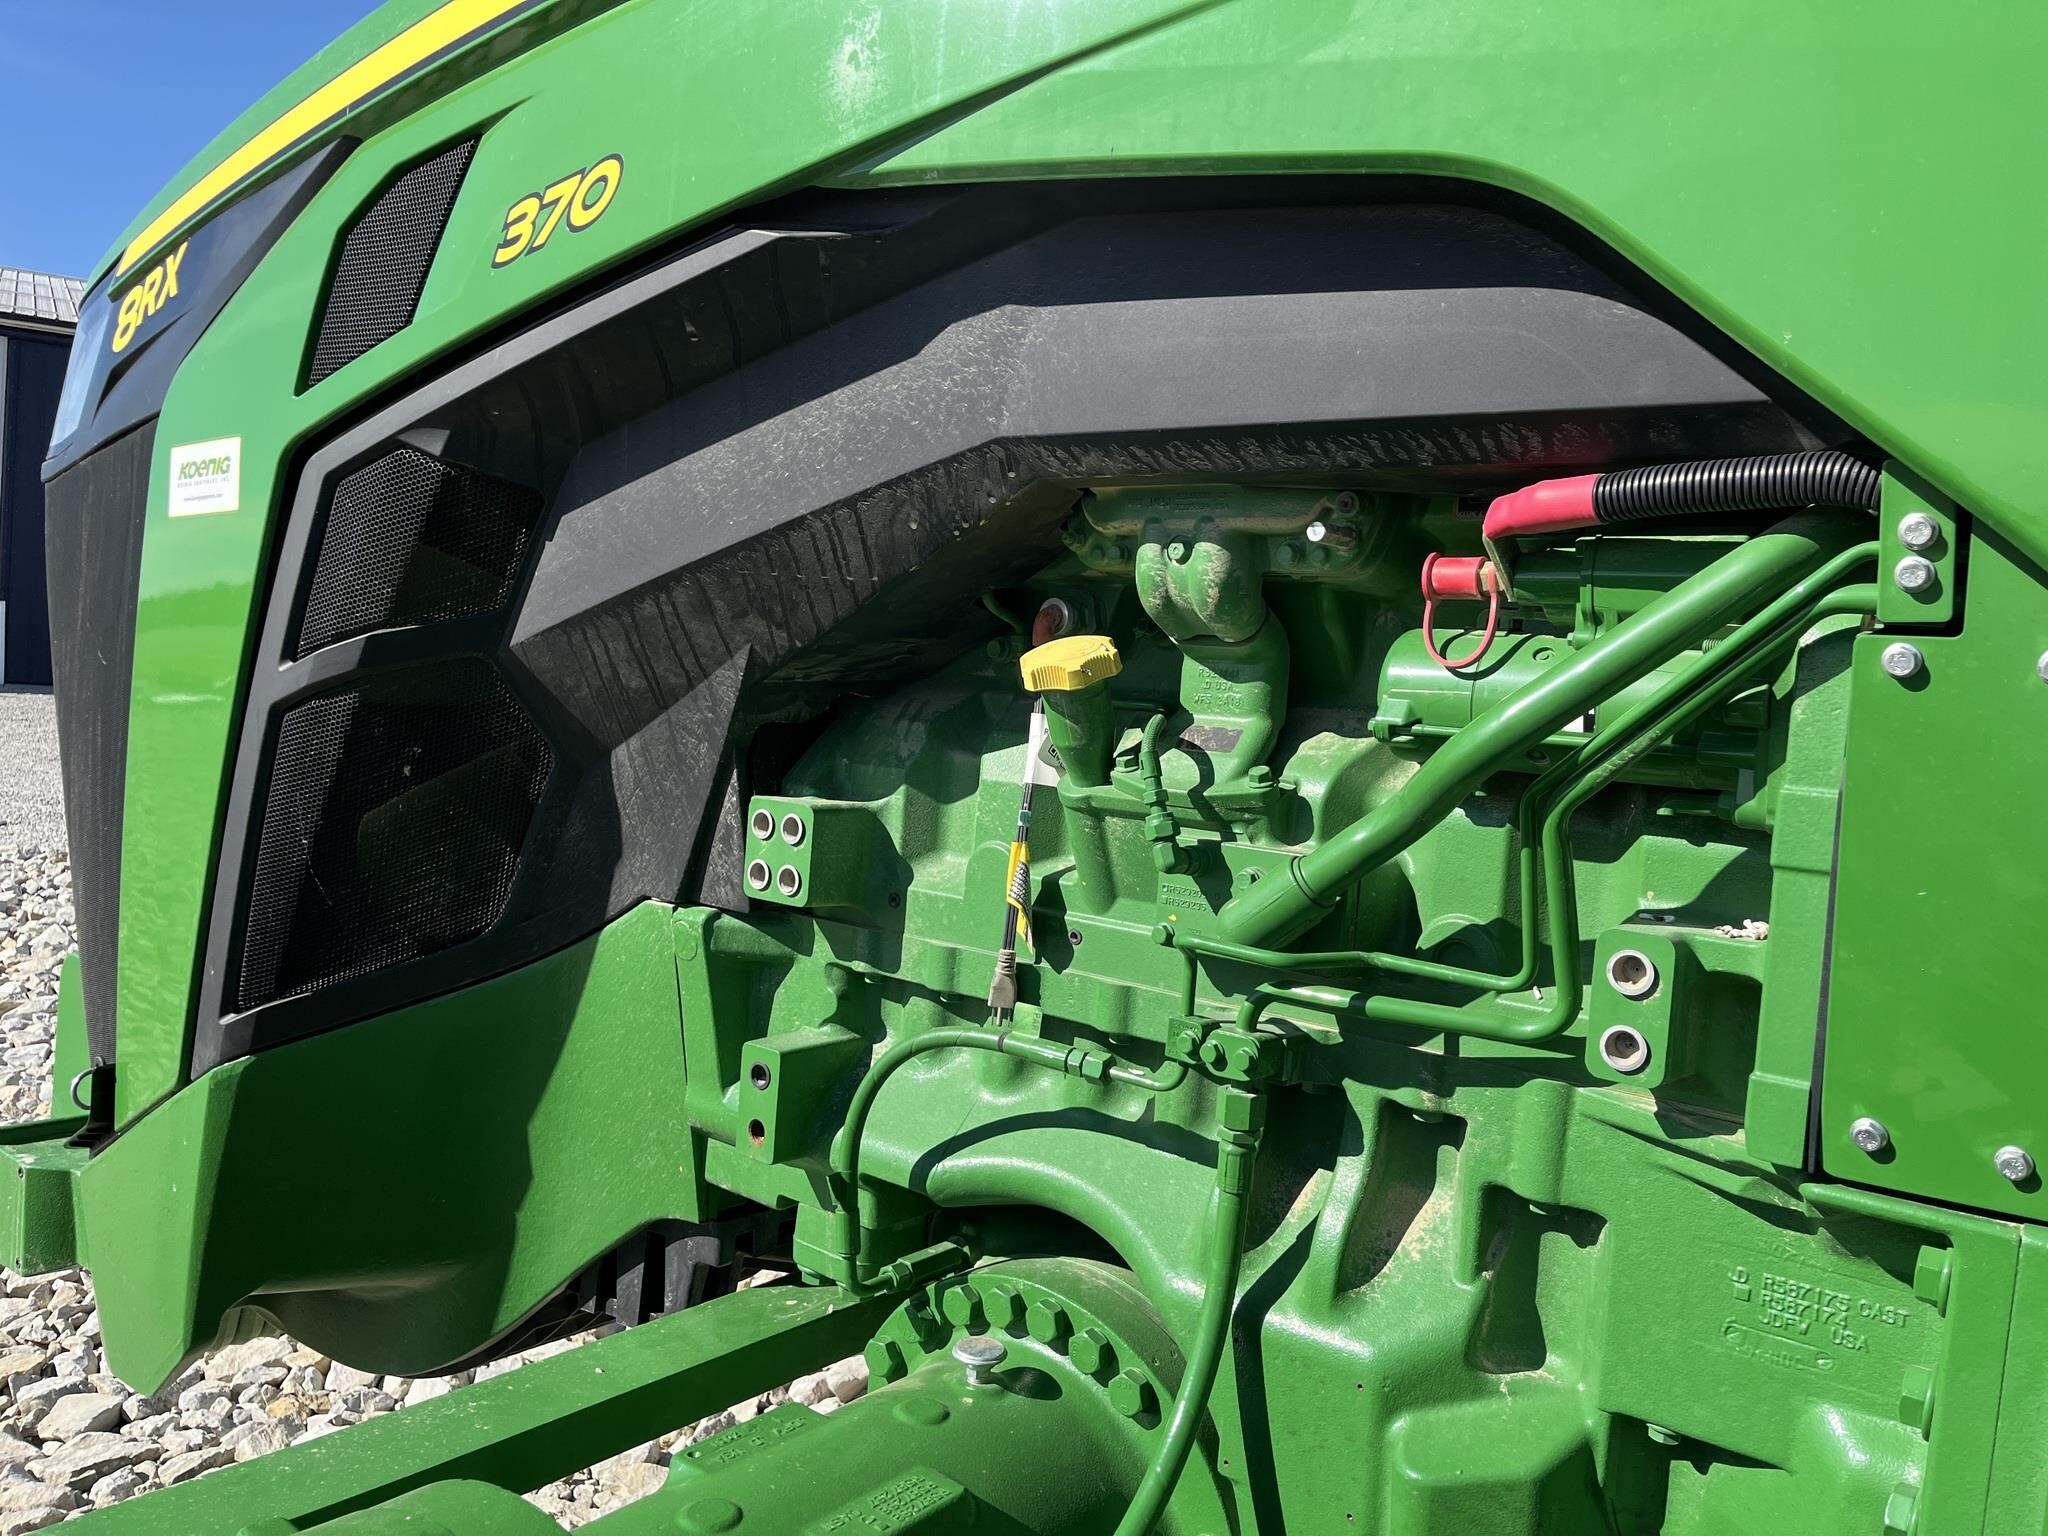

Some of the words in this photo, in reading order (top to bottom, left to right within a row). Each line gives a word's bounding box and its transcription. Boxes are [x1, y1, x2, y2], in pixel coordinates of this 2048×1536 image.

[491, 153, 624, 269] 370
[112, 241, 188, 353] 8RX
[1831, 1326, 1870, 1354] USA
[1858, 1298, 1911, 1328] CAST
